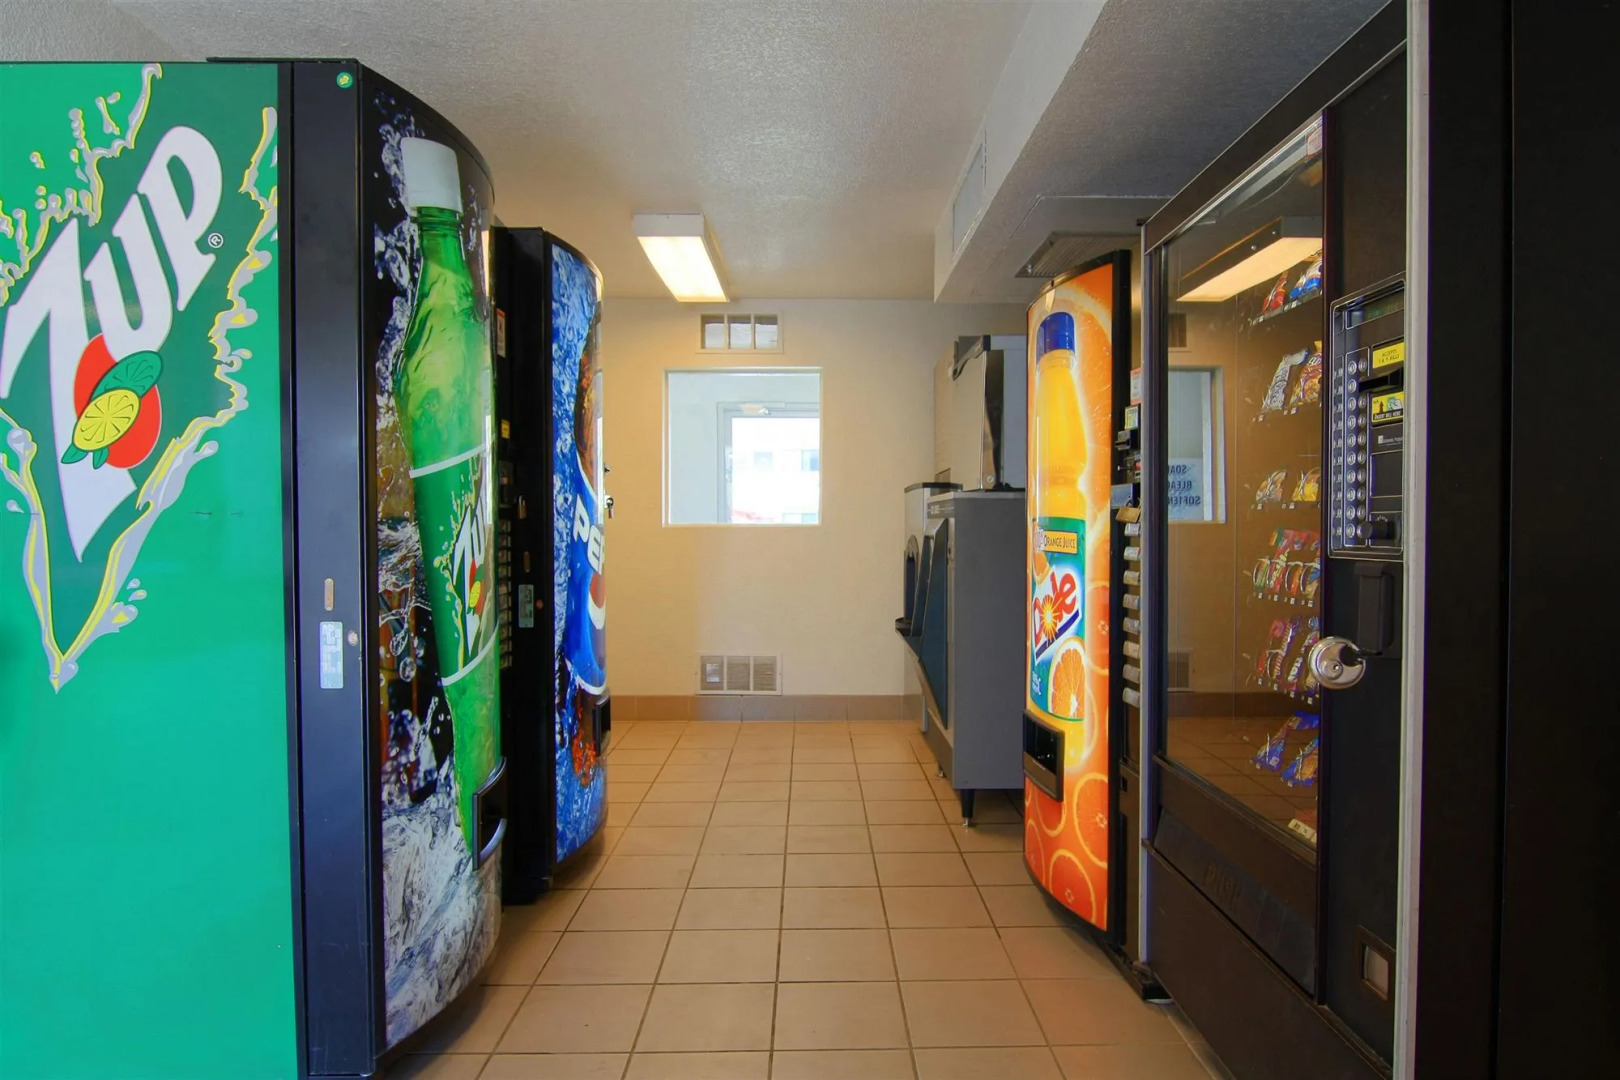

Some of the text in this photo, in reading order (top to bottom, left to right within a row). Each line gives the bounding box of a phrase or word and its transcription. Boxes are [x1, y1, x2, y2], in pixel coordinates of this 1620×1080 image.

[0, 126, 223, 562] 7UP
[573, 494, 604, 575] PE
[1044, 535, 1062, 547] ORANGE
[1062, 536, 1076, 549] JUICE
[1033, 570, 1077, 648] Dole
